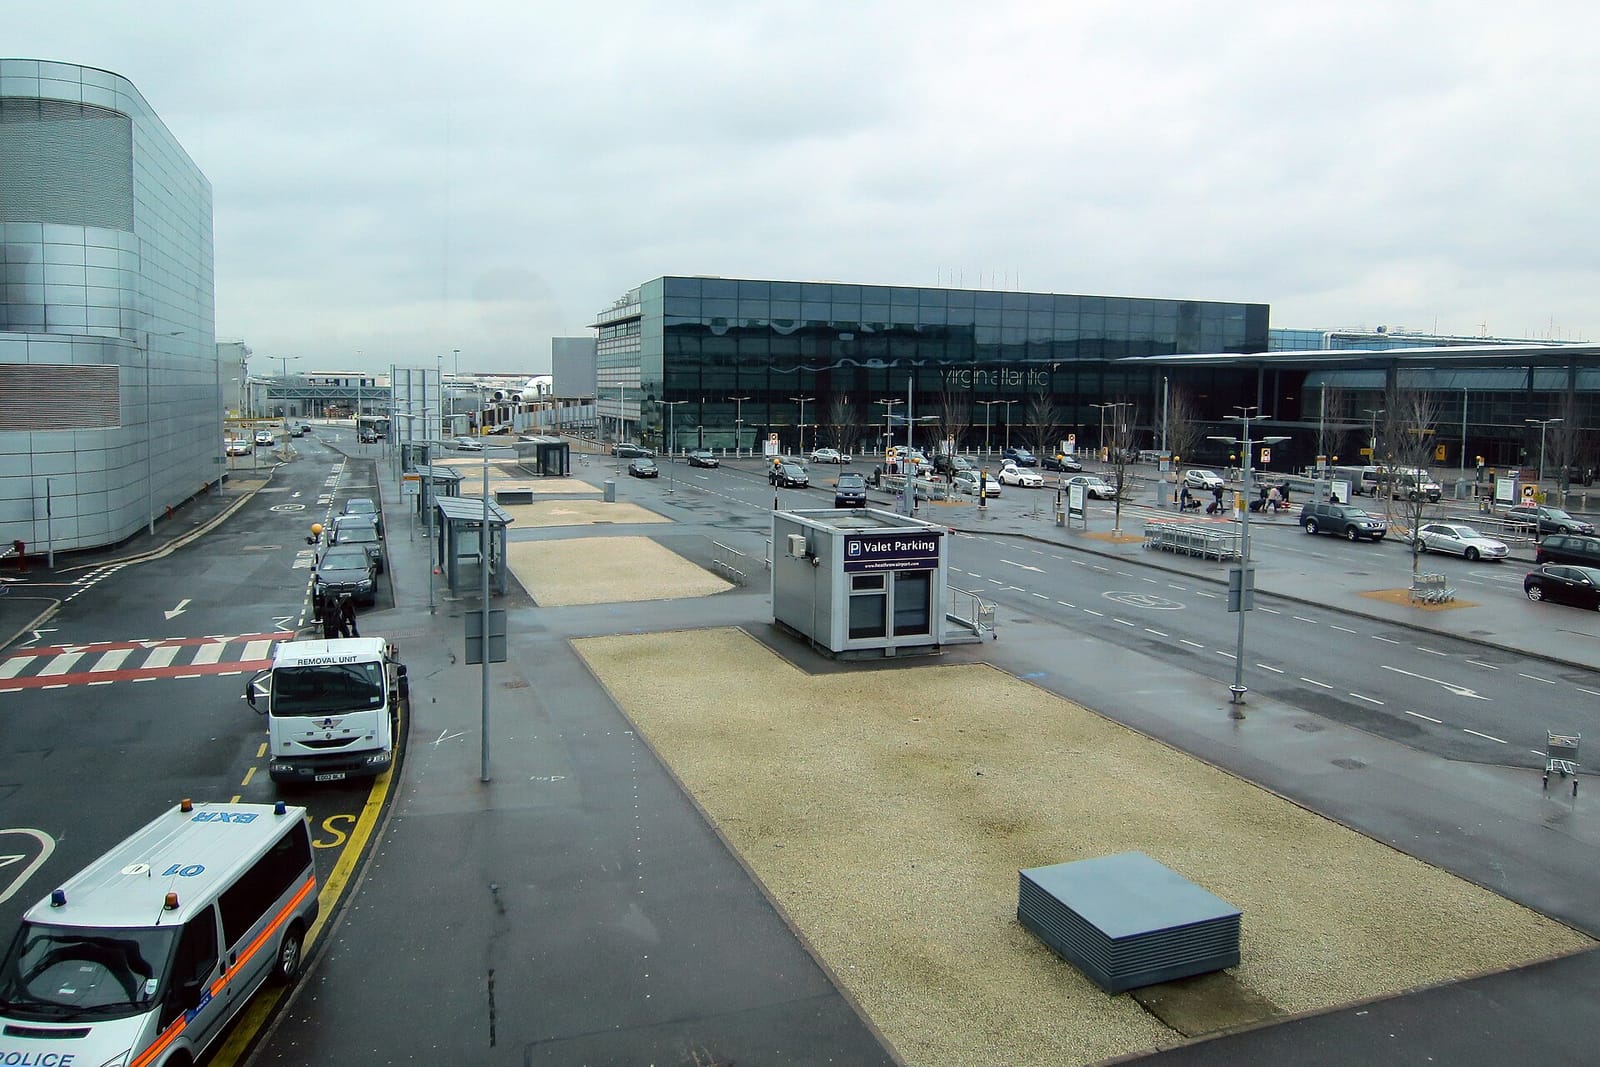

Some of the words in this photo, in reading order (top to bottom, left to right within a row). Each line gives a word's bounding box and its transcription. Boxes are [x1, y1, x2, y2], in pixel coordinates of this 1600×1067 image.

[940, 366, 988, 388] virgin
[990, 367, 1049, 386] atlantic
[863, 541, 892, 553] Valet
[894, 540, 936, 552] Parking
[297, 657, 337, 666] REMOVAL
[338, 655, 358, 664] UNIT
